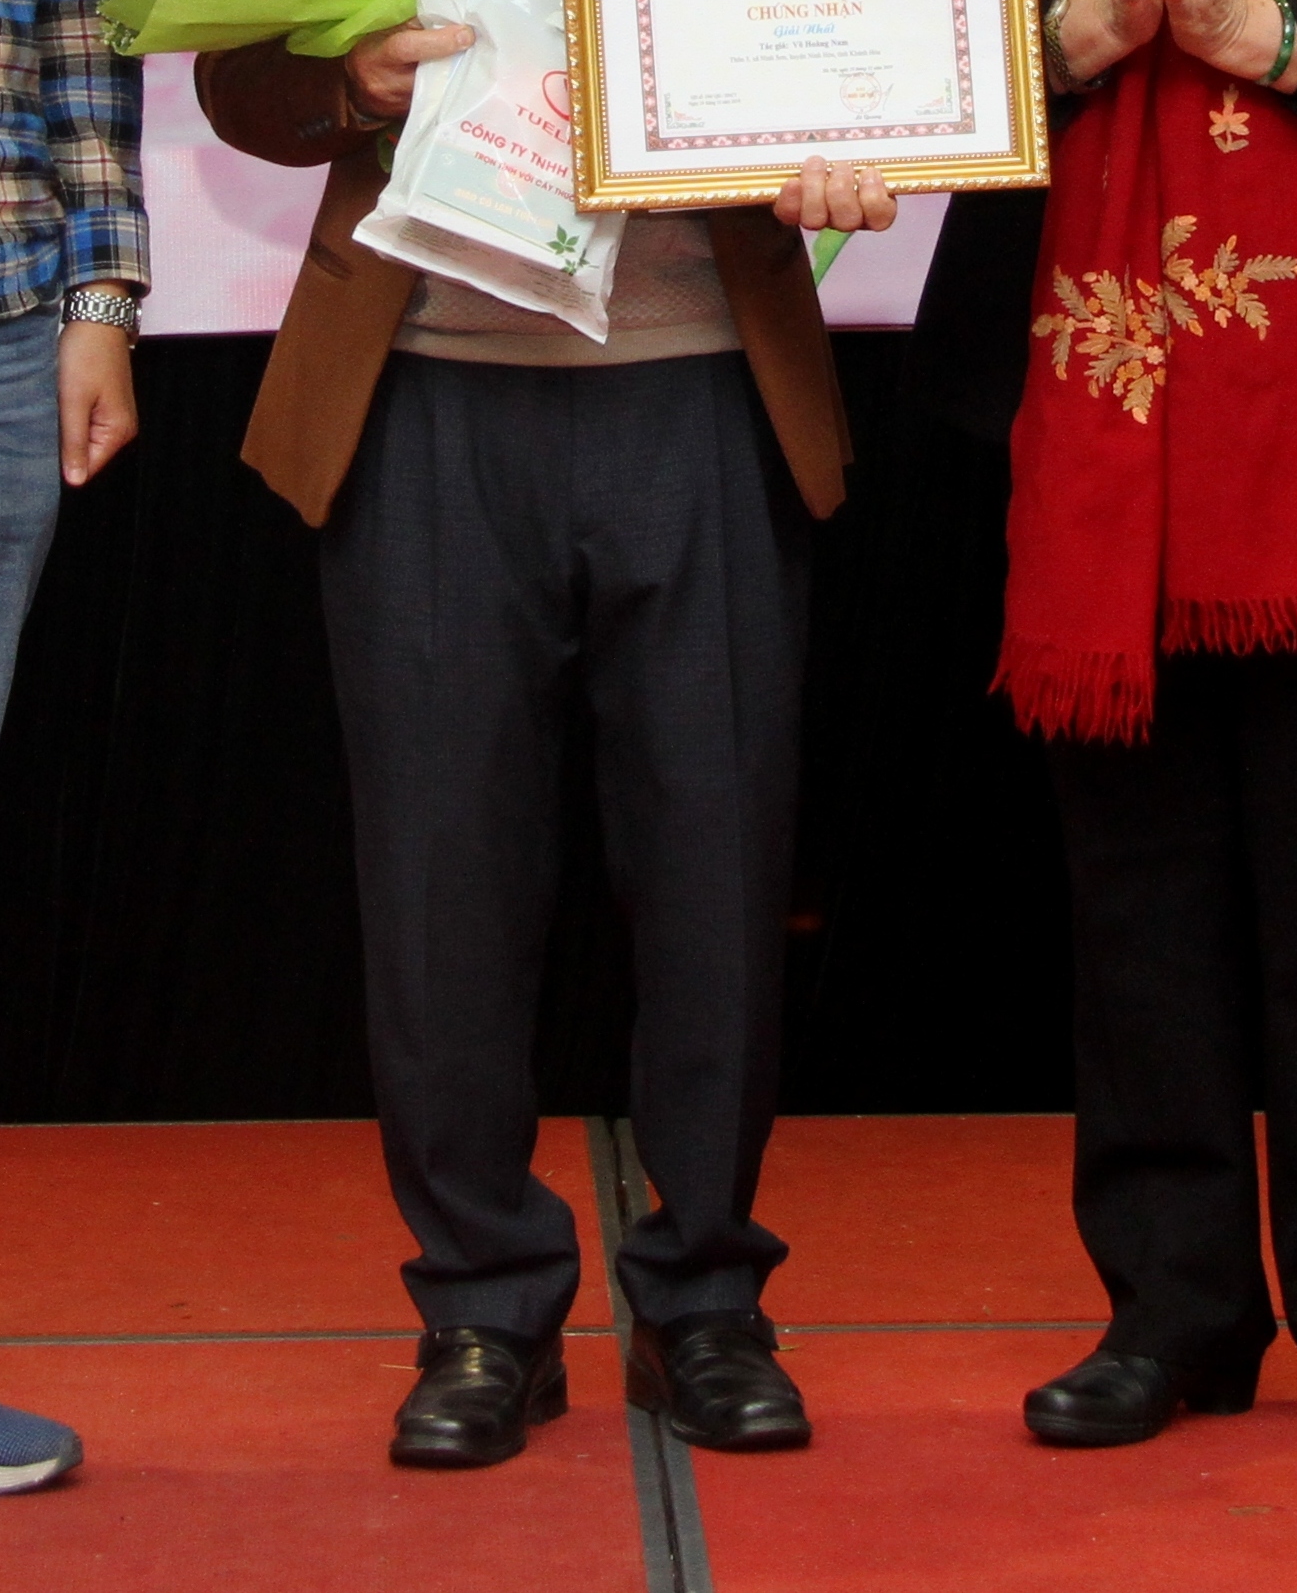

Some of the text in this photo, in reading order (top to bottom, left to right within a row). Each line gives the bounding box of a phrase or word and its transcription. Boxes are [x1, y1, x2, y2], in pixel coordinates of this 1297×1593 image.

[746, 2, 809, 21] CHỨNG
[459, 119, 569, 178] CÔNG TY TNHH
